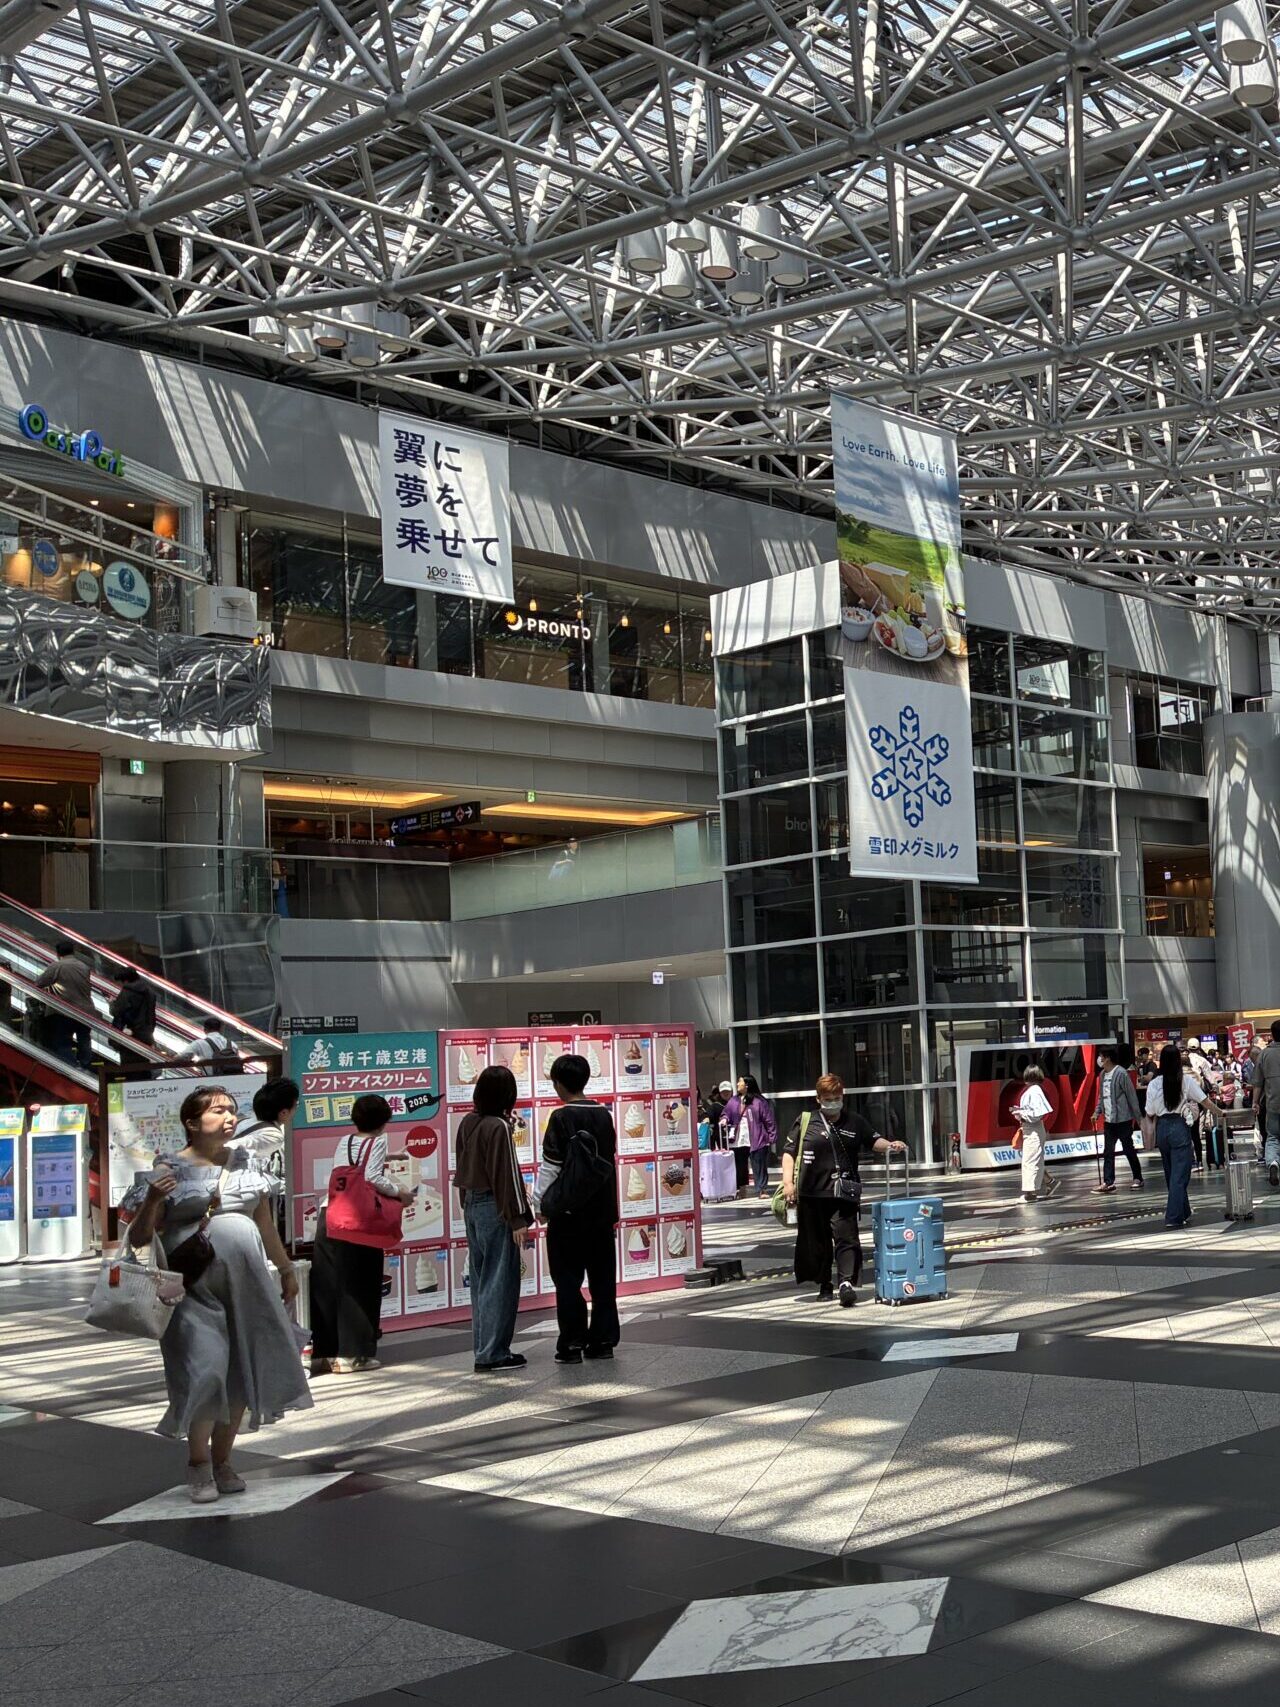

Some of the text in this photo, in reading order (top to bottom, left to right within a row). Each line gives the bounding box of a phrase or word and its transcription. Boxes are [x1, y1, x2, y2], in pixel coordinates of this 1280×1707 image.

[393, 428, 462, 472] 翼に
[843, 436, 948, 477] Love Earth. Love Life.
[394, 472, 463, 517] 夢を
[396, 517, 499, 567] 乗せて
[528, 617, 591, 640] PRONTO
[869, 836, 959, 859] 雪印メグミルク
[1032, 1025, 1067, 1034] nformation
[338, 1048, 427, 1067] 新千歳空港
[305, 1072, 427, 1090] ソフト・アイスクリーム
[409, 1094, 428, 1107] 2026
[994, 1149, 1016, 1162] NEW
[1056, 1141, 1092, 1154] AIRPORT
